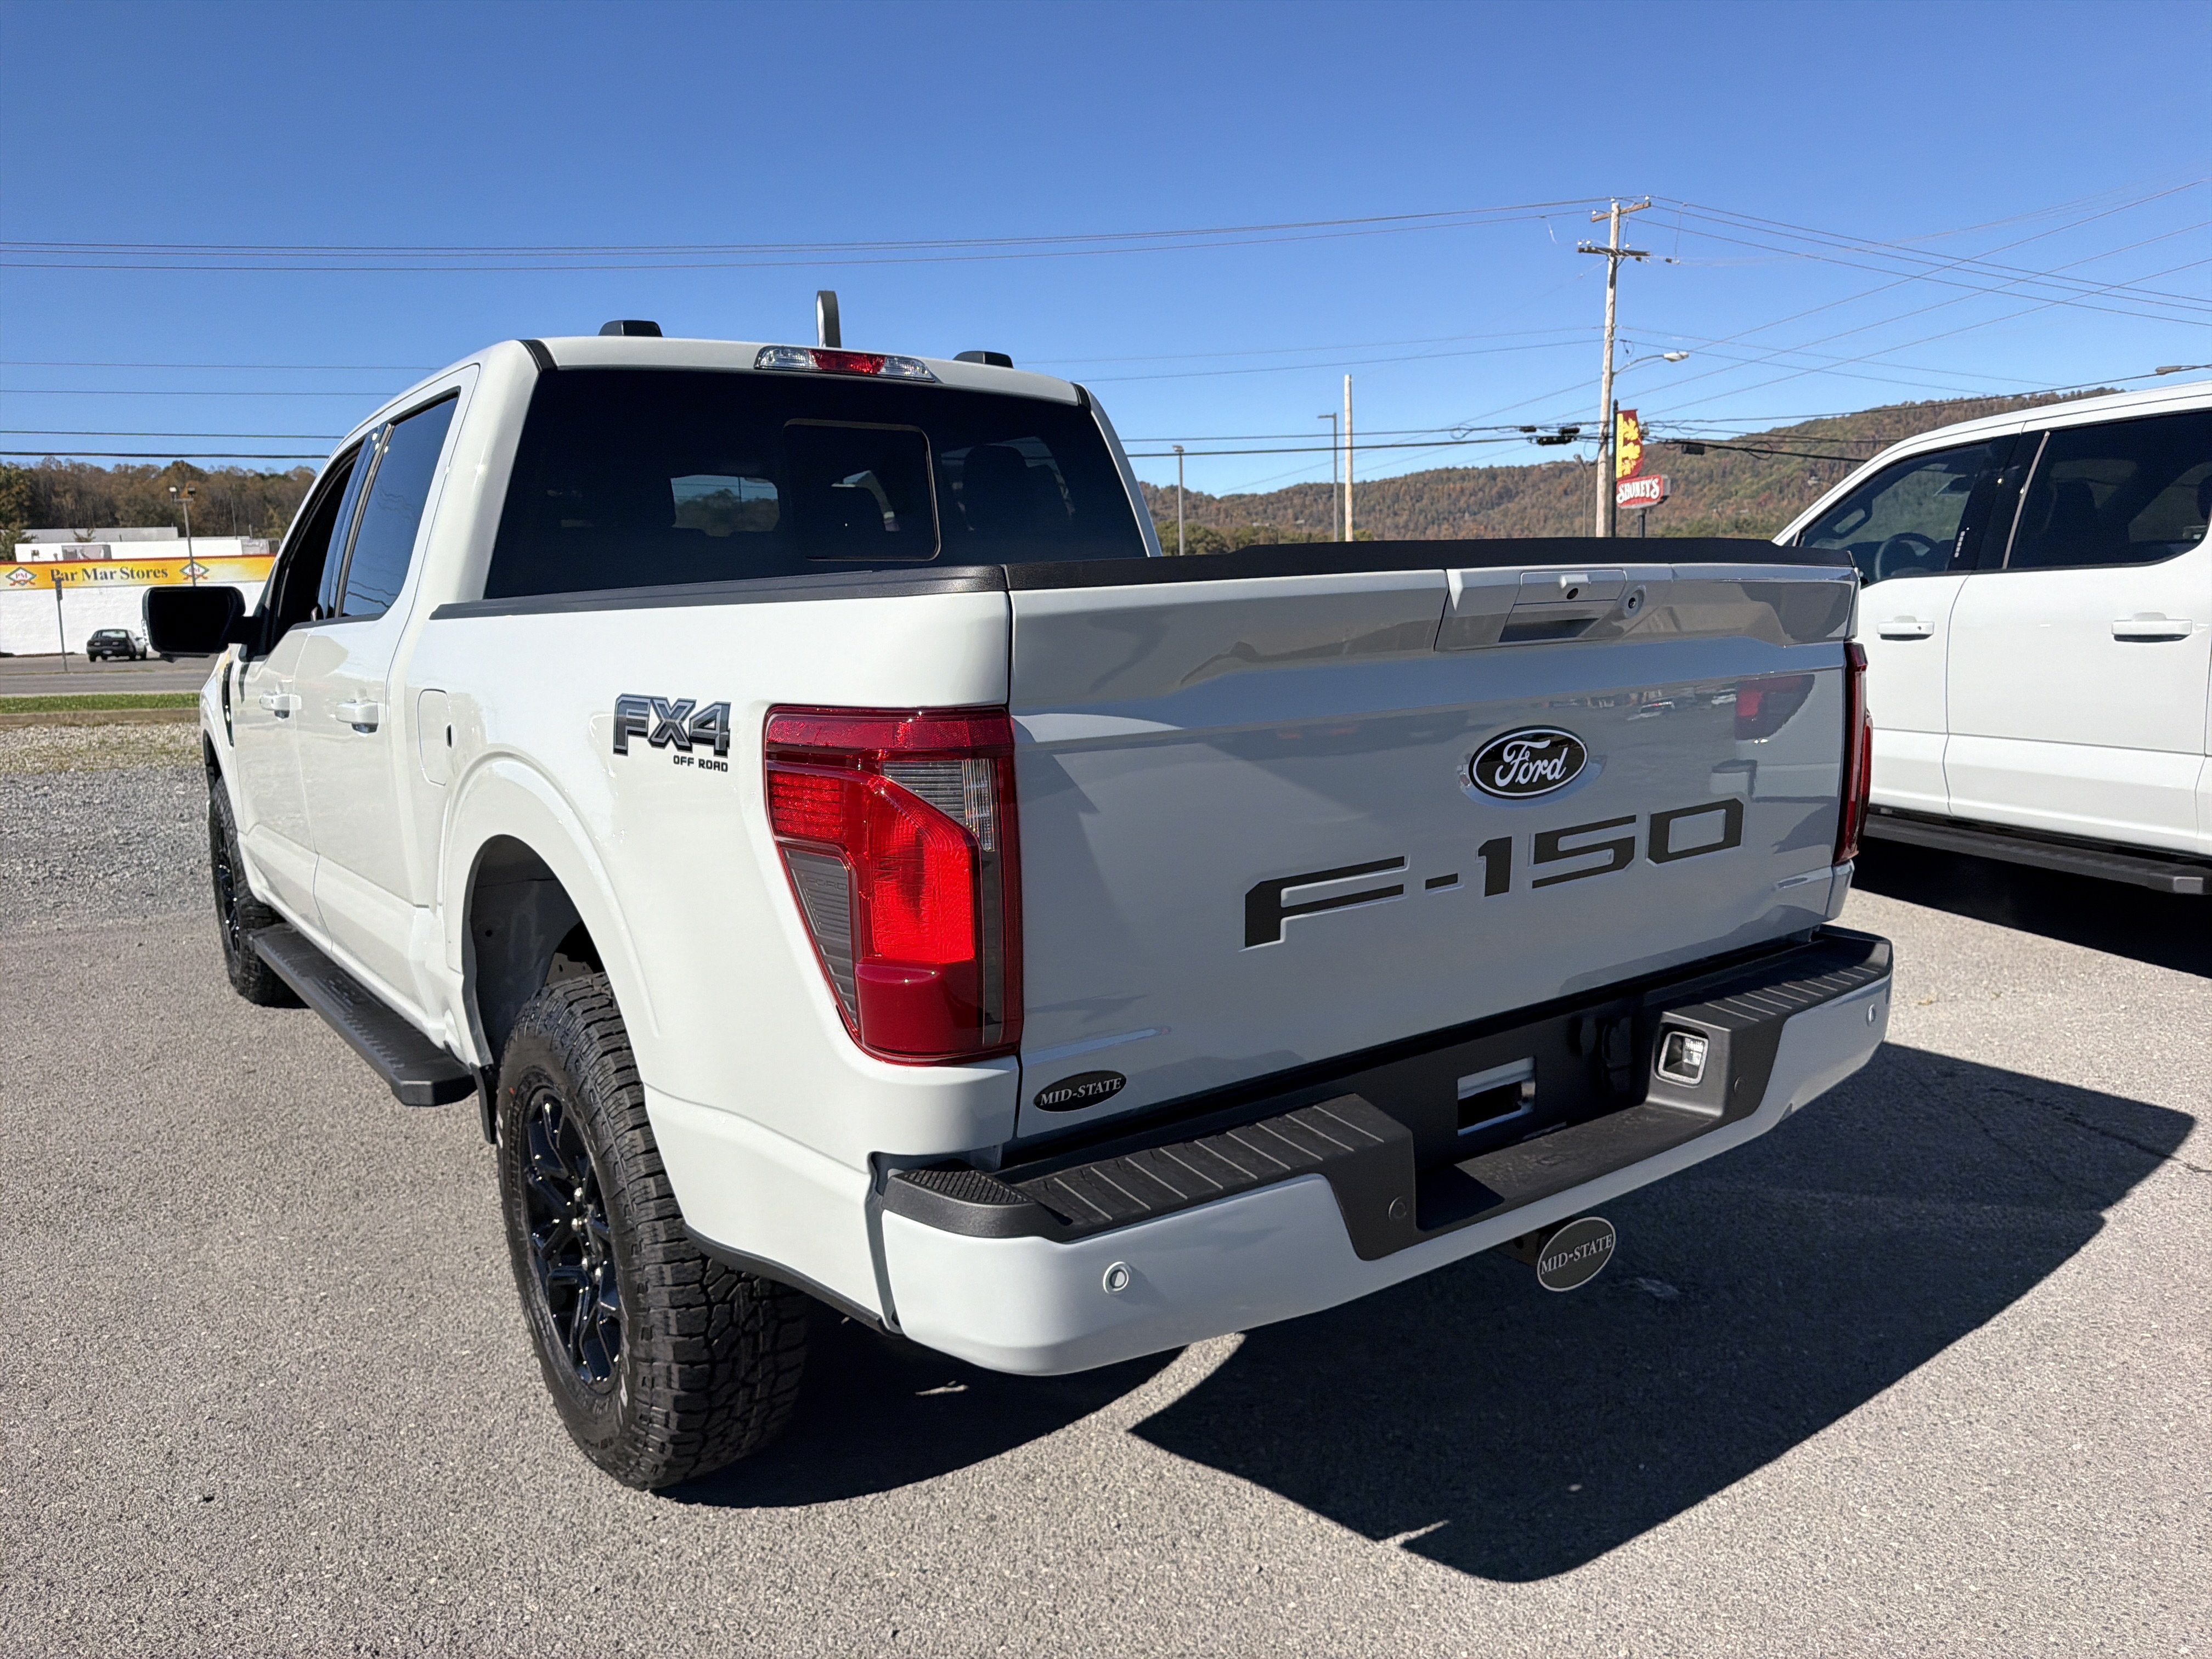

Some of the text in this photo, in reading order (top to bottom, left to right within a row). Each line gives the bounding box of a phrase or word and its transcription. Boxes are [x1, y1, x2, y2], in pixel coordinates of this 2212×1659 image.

[50, 566, 168, 582] Par Mar Stores
[613, 693, 731, 758] FX4
[673, 755, 728, 772] OFF ROAD
[1494, 738, 1567, 787] Ford
[1242, 798, 1745, 949] F-150
[1040, 1077, 1122, 1106] MID-STATE
[1540, 1233, 1612, 1275] MID-STATE
